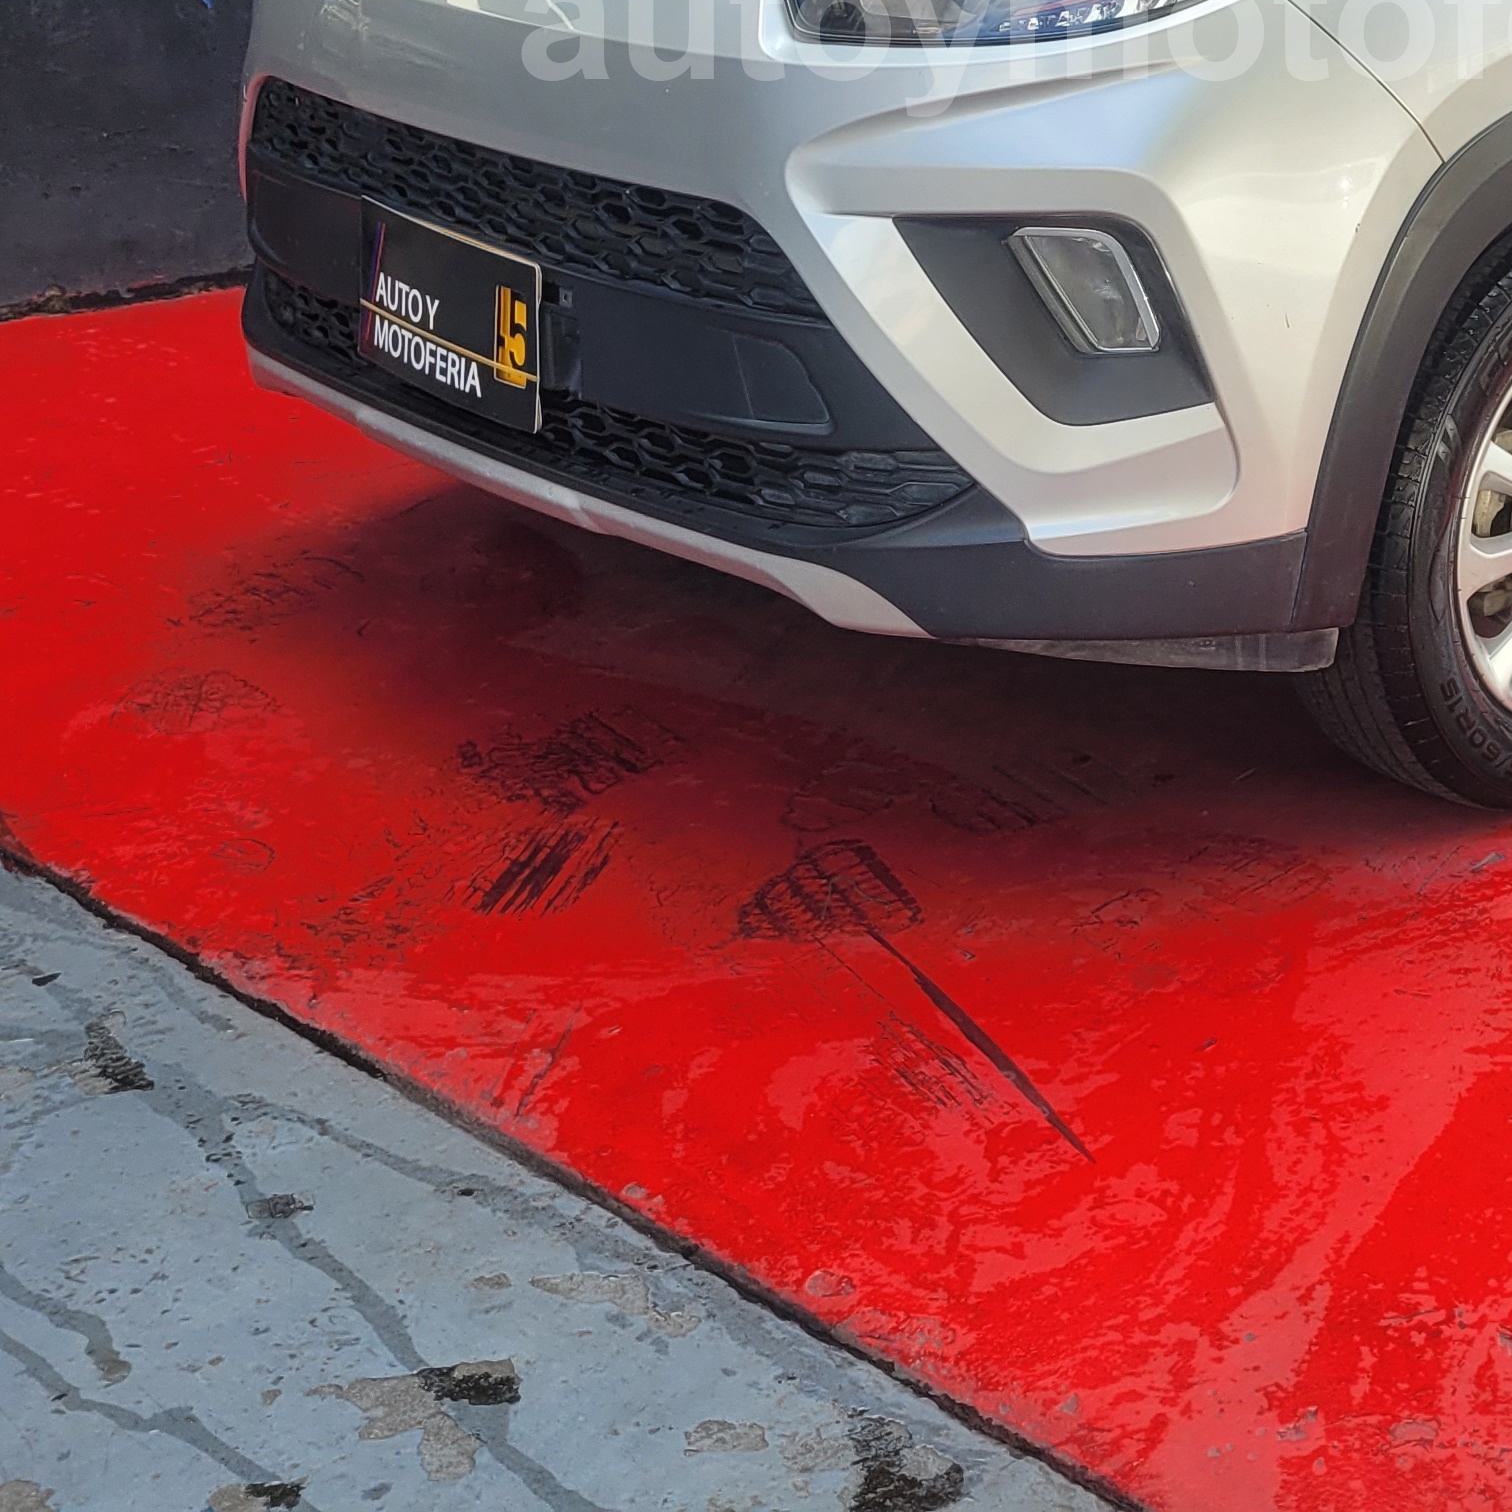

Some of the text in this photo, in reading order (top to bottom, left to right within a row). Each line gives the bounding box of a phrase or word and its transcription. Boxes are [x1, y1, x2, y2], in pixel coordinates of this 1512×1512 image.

[375, 271, 440, 330] AUTO Y
[373, 314, 482, 399] MOTOFERIA
